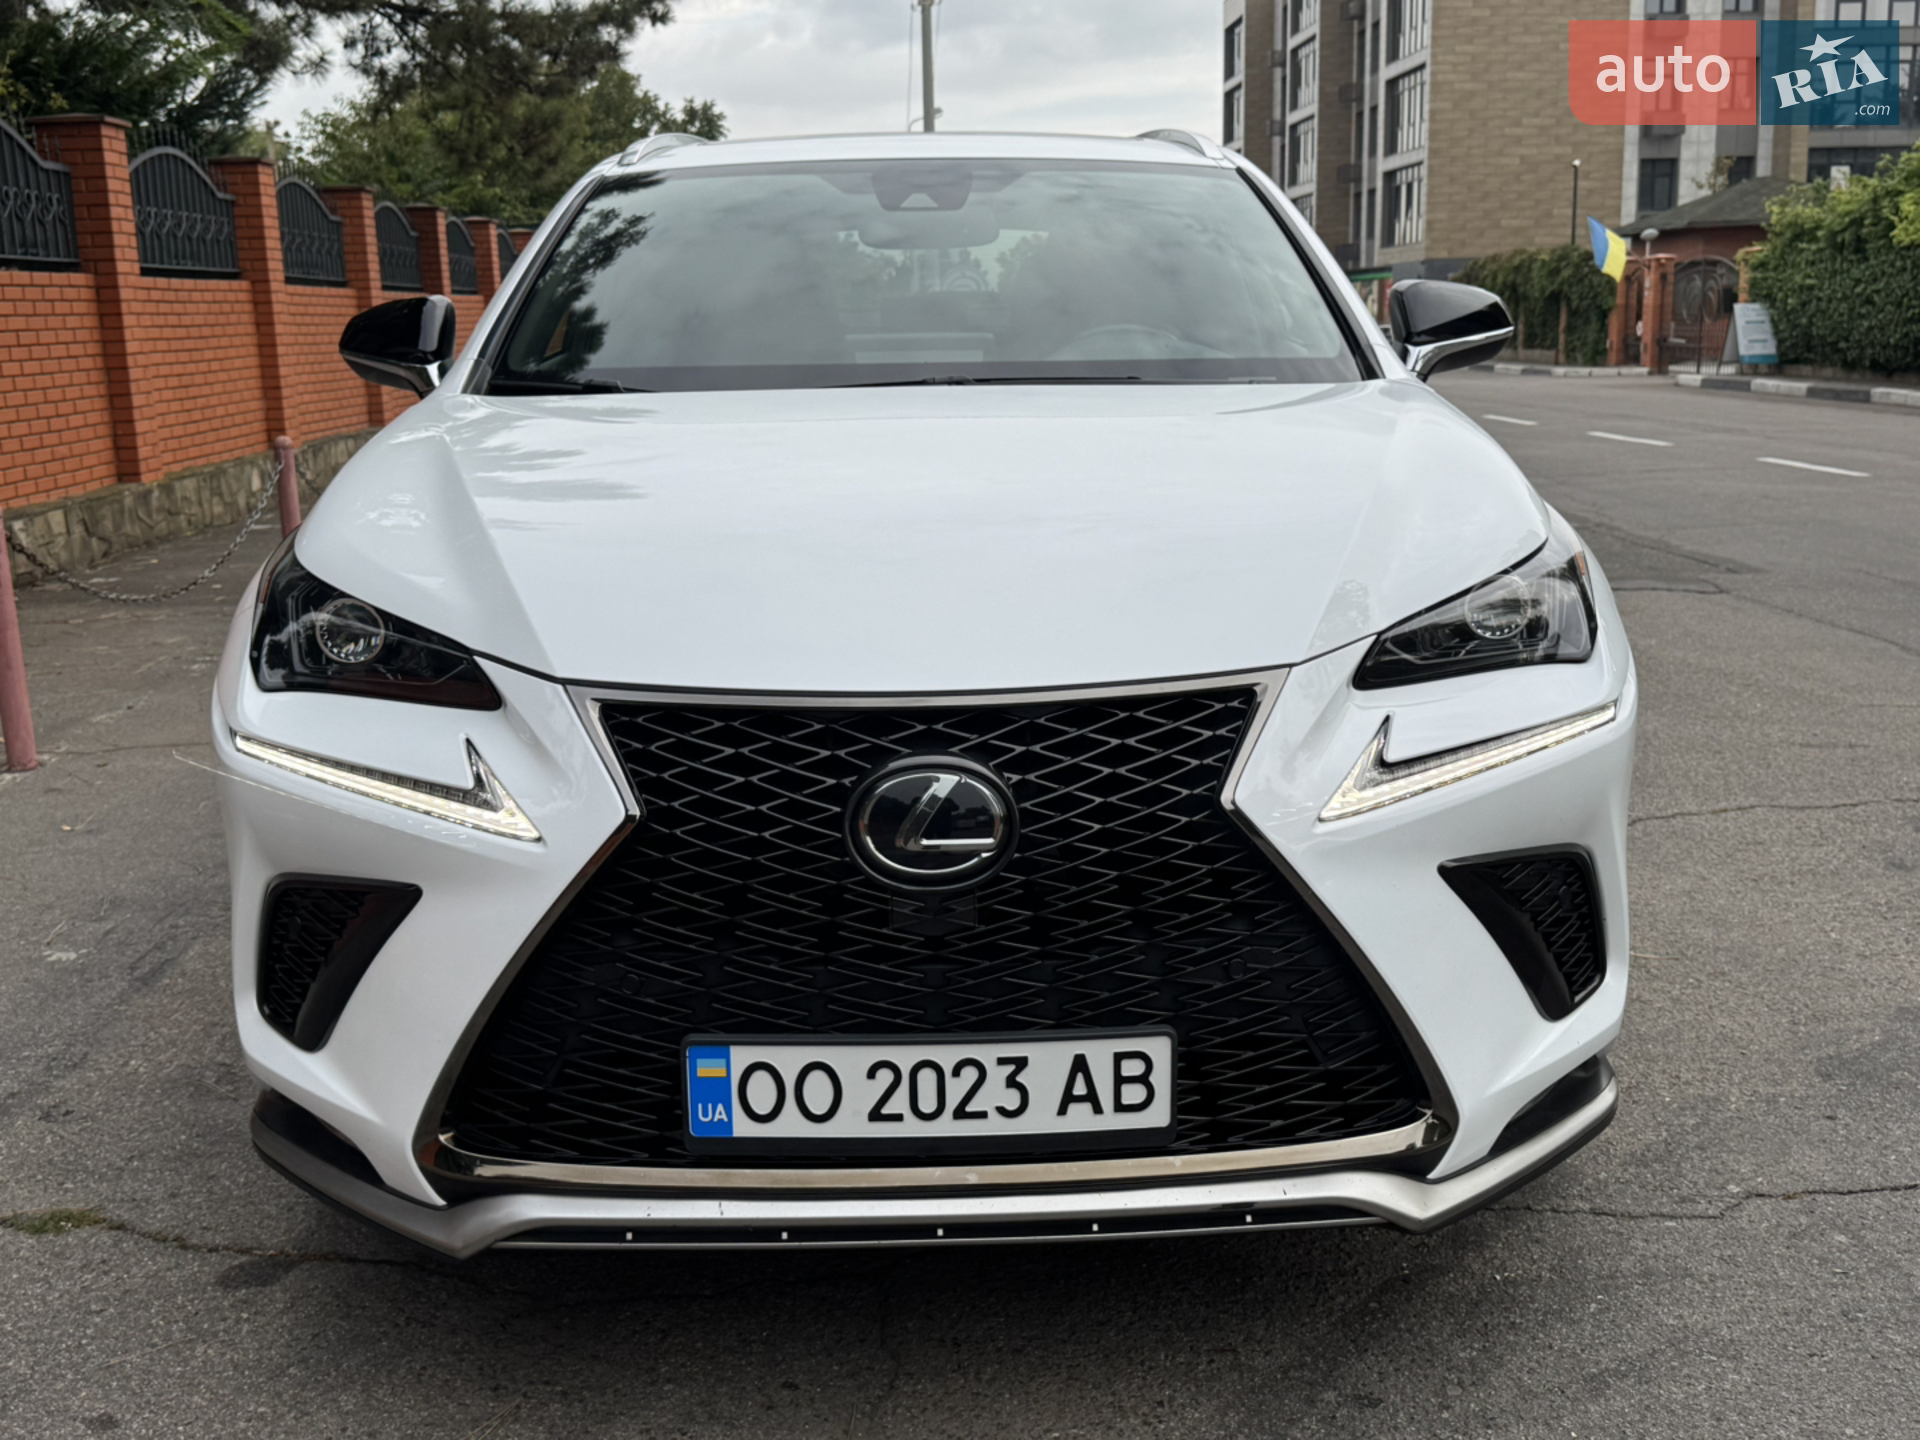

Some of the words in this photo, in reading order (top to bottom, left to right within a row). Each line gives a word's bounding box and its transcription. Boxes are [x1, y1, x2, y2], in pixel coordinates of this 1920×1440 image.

[866, 1056, 1030, 1122] 2023
[1056, 1050, 1156, 1116] AB
[698, 1104, 728, 1122] UA
